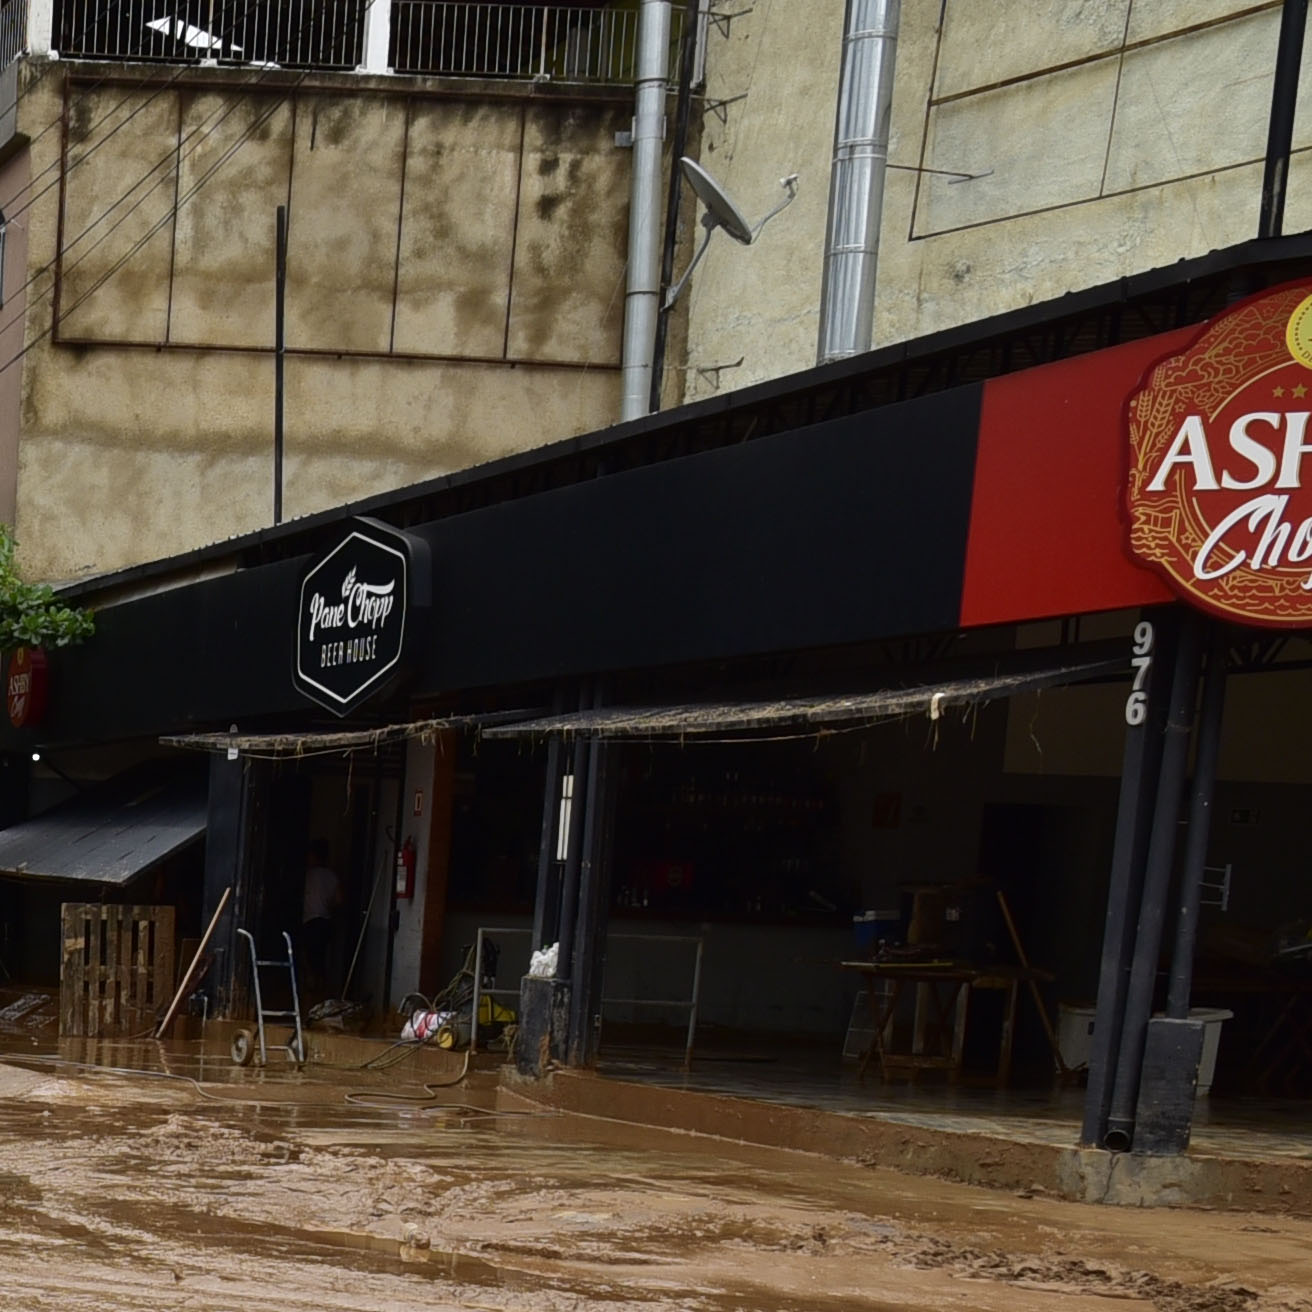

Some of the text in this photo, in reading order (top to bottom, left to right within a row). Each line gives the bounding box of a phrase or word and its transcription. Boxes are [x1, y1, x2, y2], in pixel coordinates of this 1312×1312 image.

[309, 578, 396, 642] Pane Chopp
[321, 635, 378, 668] BEER HOUSE
[1126, 621, 1154, 726] 976
